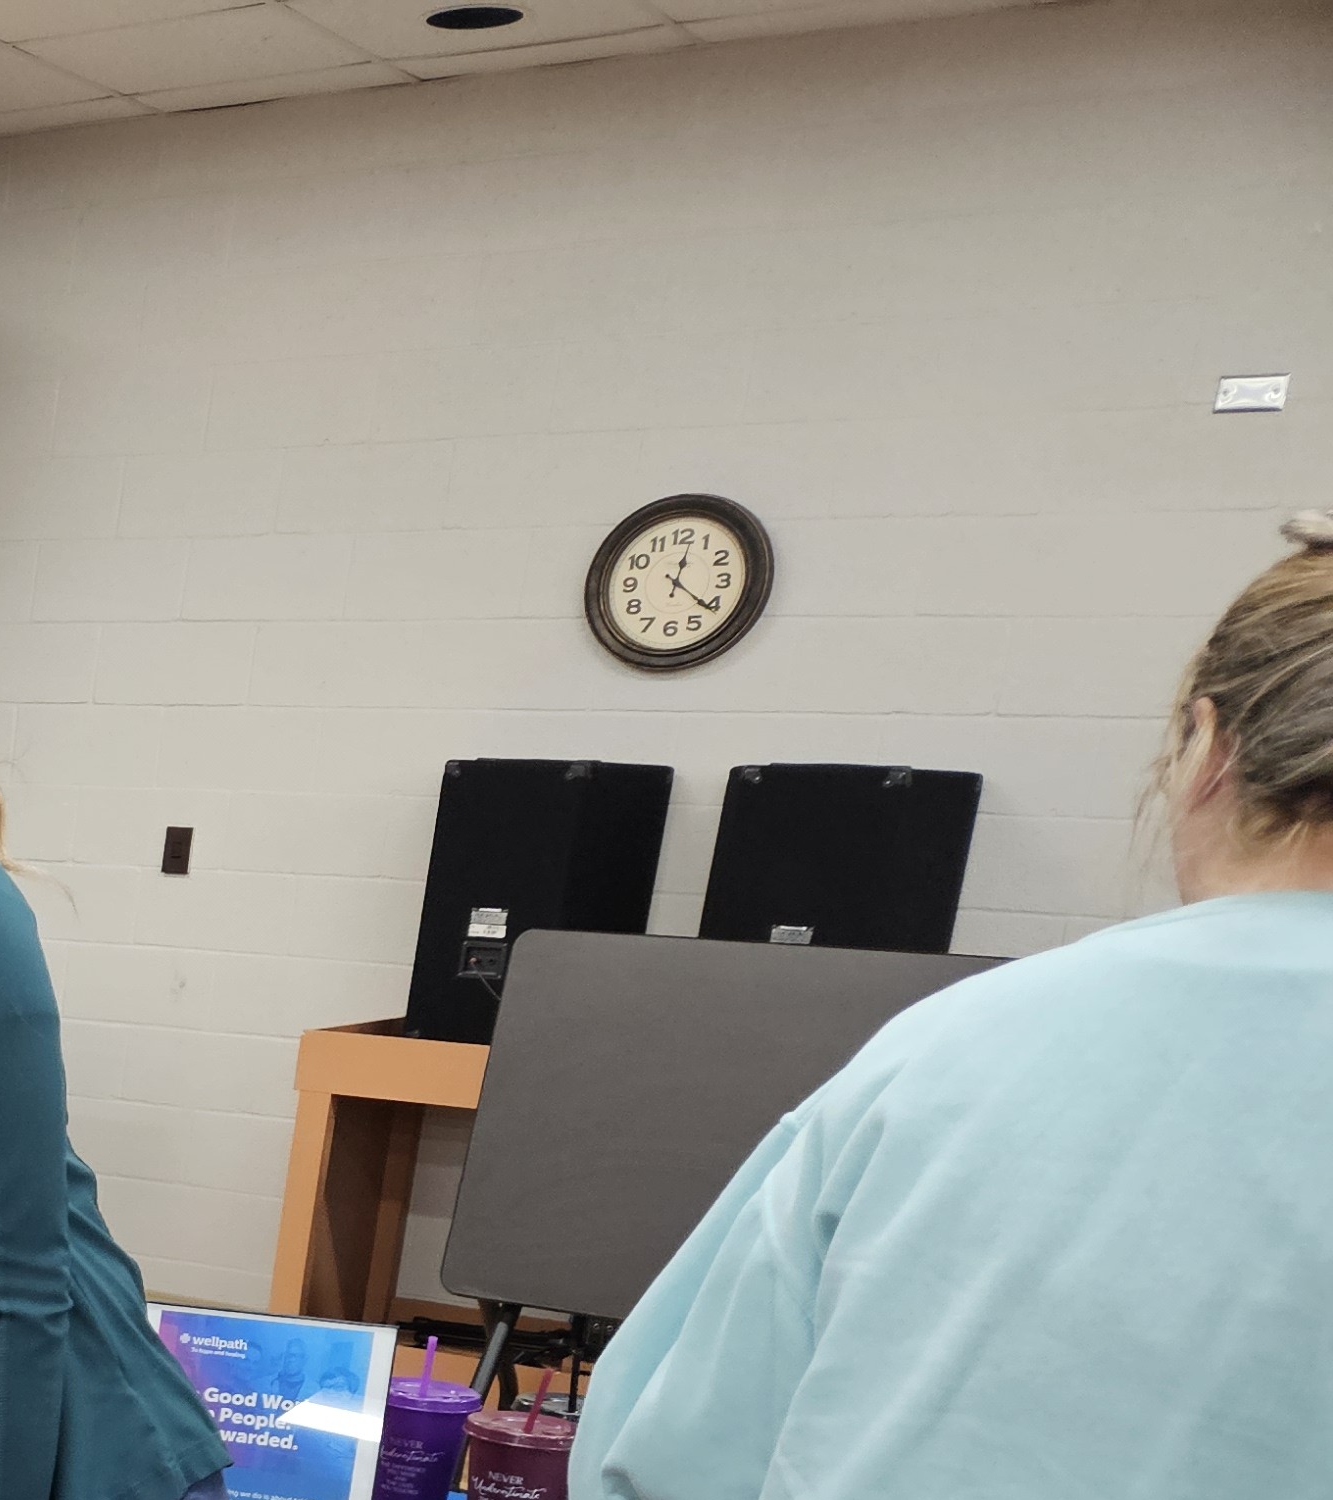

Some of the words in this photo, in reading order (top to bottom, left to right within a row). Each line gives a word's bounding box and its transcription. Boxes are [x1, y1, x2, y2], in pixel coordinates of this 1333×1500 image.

[650, 536, 666, 552] 11
[672, 528, 695, 545] 12
[702, 534, 710, 550] 1
[629, 554, 650, 570] 10
[713, 550, 729, 566] 2
[623, 577, 638, 593] 9
[716, 573, 731, 589] 3
[626, 599, 641, 615] 8
[707, 595, 721, 611] 4
[640, 617, 656, 633] 7
[663, 621, 678, 636] 6
[686, 615, 702, 631] 5
[192, 1336, 248, 1350] wellpath
[203, 1387, 257, 1407] Good
[488, 1471, 524, 1484] NEVER
